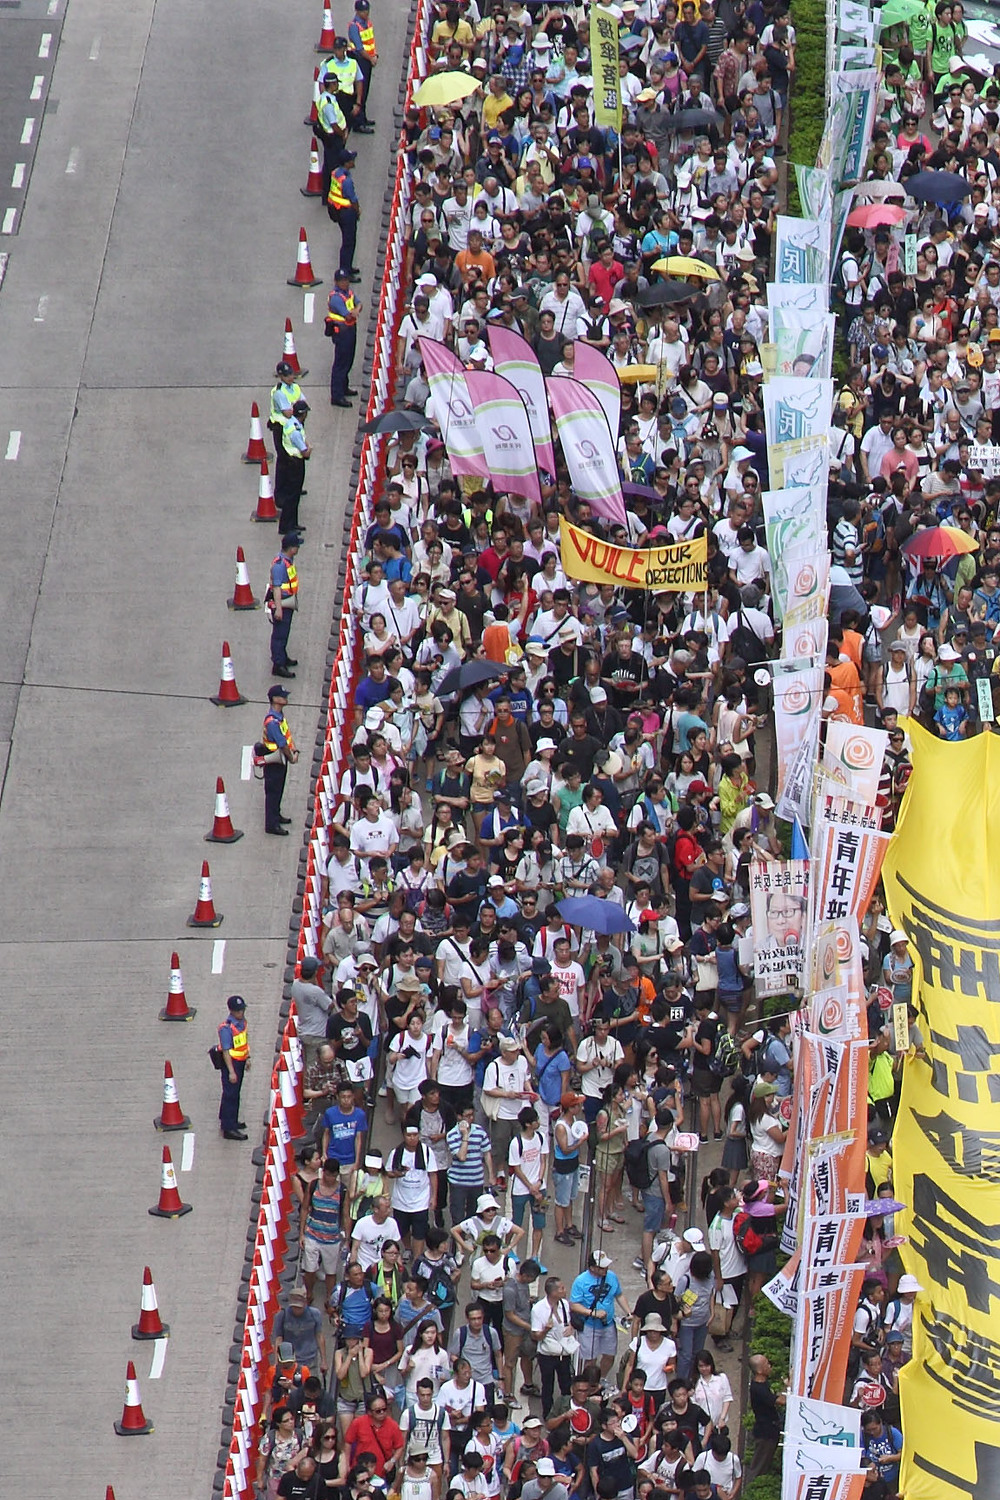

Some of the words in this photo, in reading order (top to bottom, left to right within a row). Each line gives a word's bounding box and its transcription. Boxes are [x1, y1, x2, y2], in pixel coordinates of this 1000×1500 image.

[568, 528, 644, 583] VOICE
[657, 544, 691, 565] OUR
[645, 562, 709, 586] OBJECTIONS
